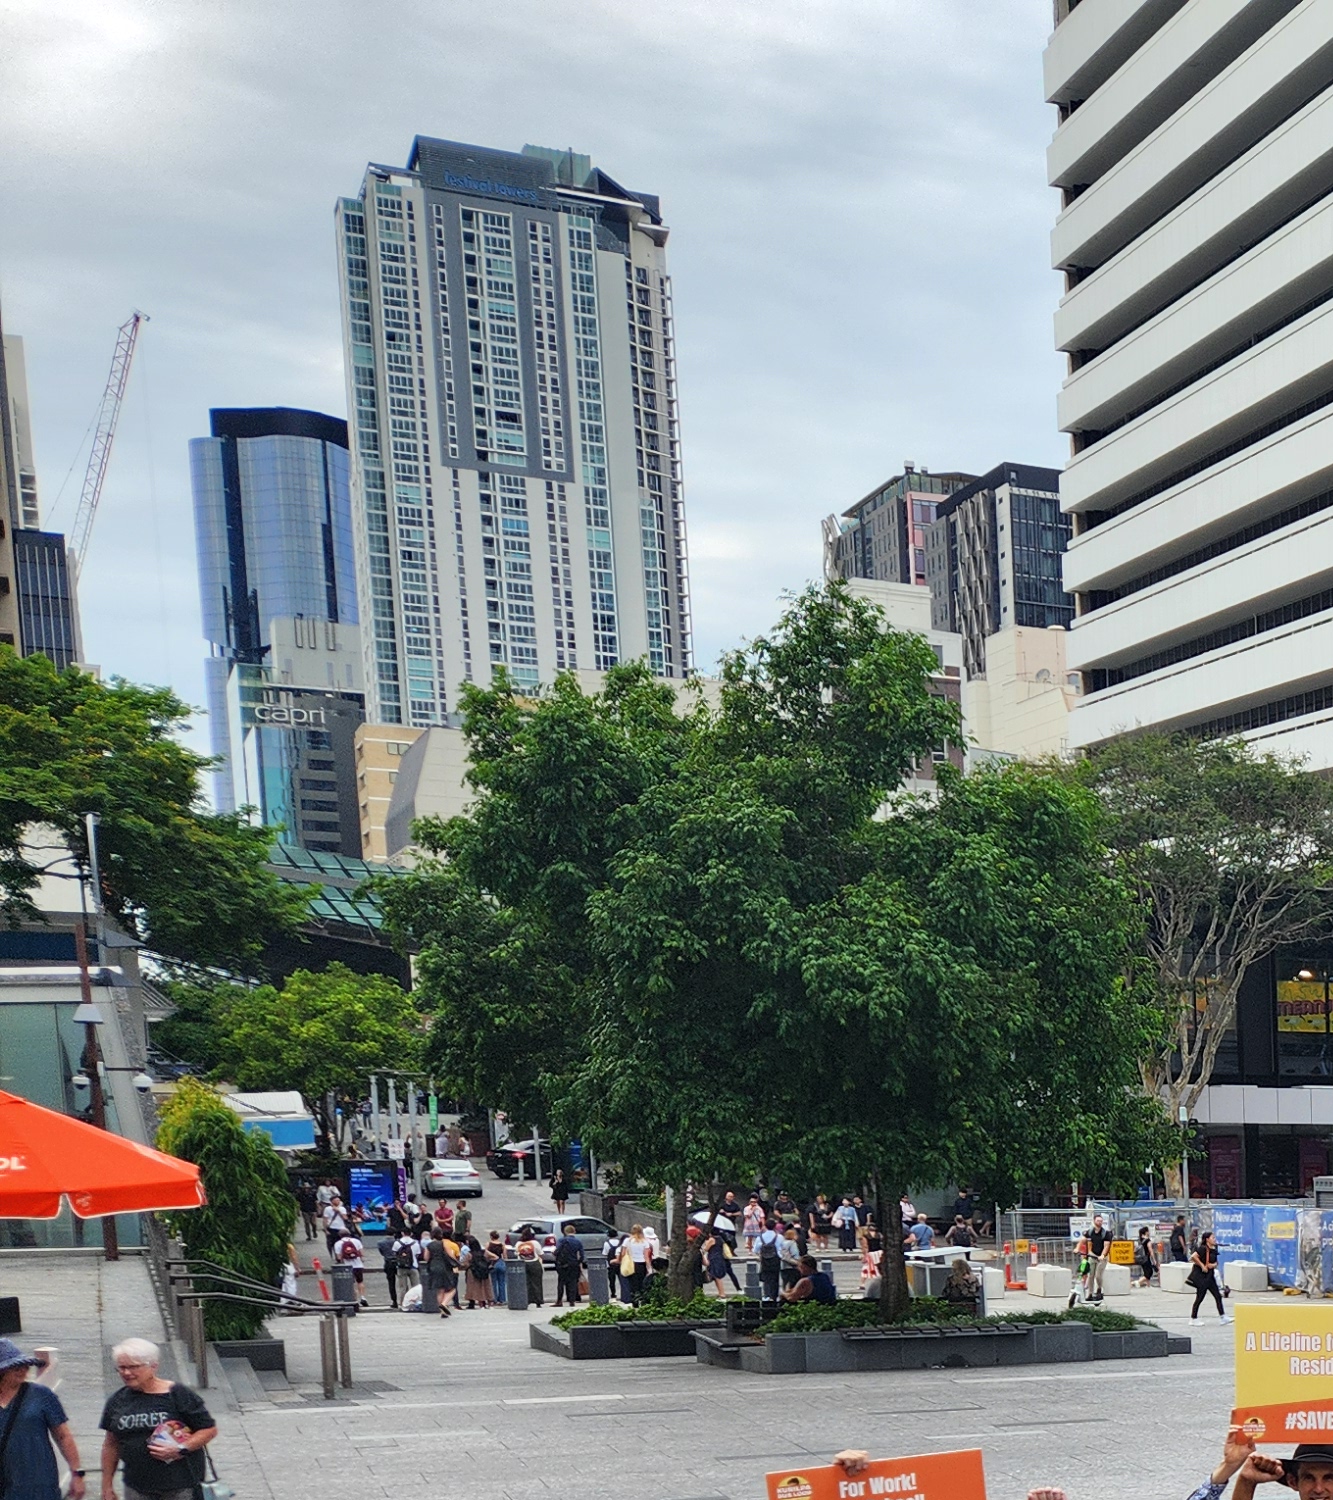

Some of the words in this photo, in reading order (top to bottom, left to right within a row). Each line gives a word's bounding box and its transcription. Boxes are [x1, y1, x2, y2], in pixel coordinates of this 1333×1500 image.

[444, 169, 492, 192] festival
[495, 182, 536, 200] towers
[255, 706, 325, 725] capri
[1244, 1335, 1257, 1352] A
[1260, 1331, 1322, 1353] Lifeline
[838, 1481, 865, 1499] For
[868, 1472, 917, 1495] Work!
